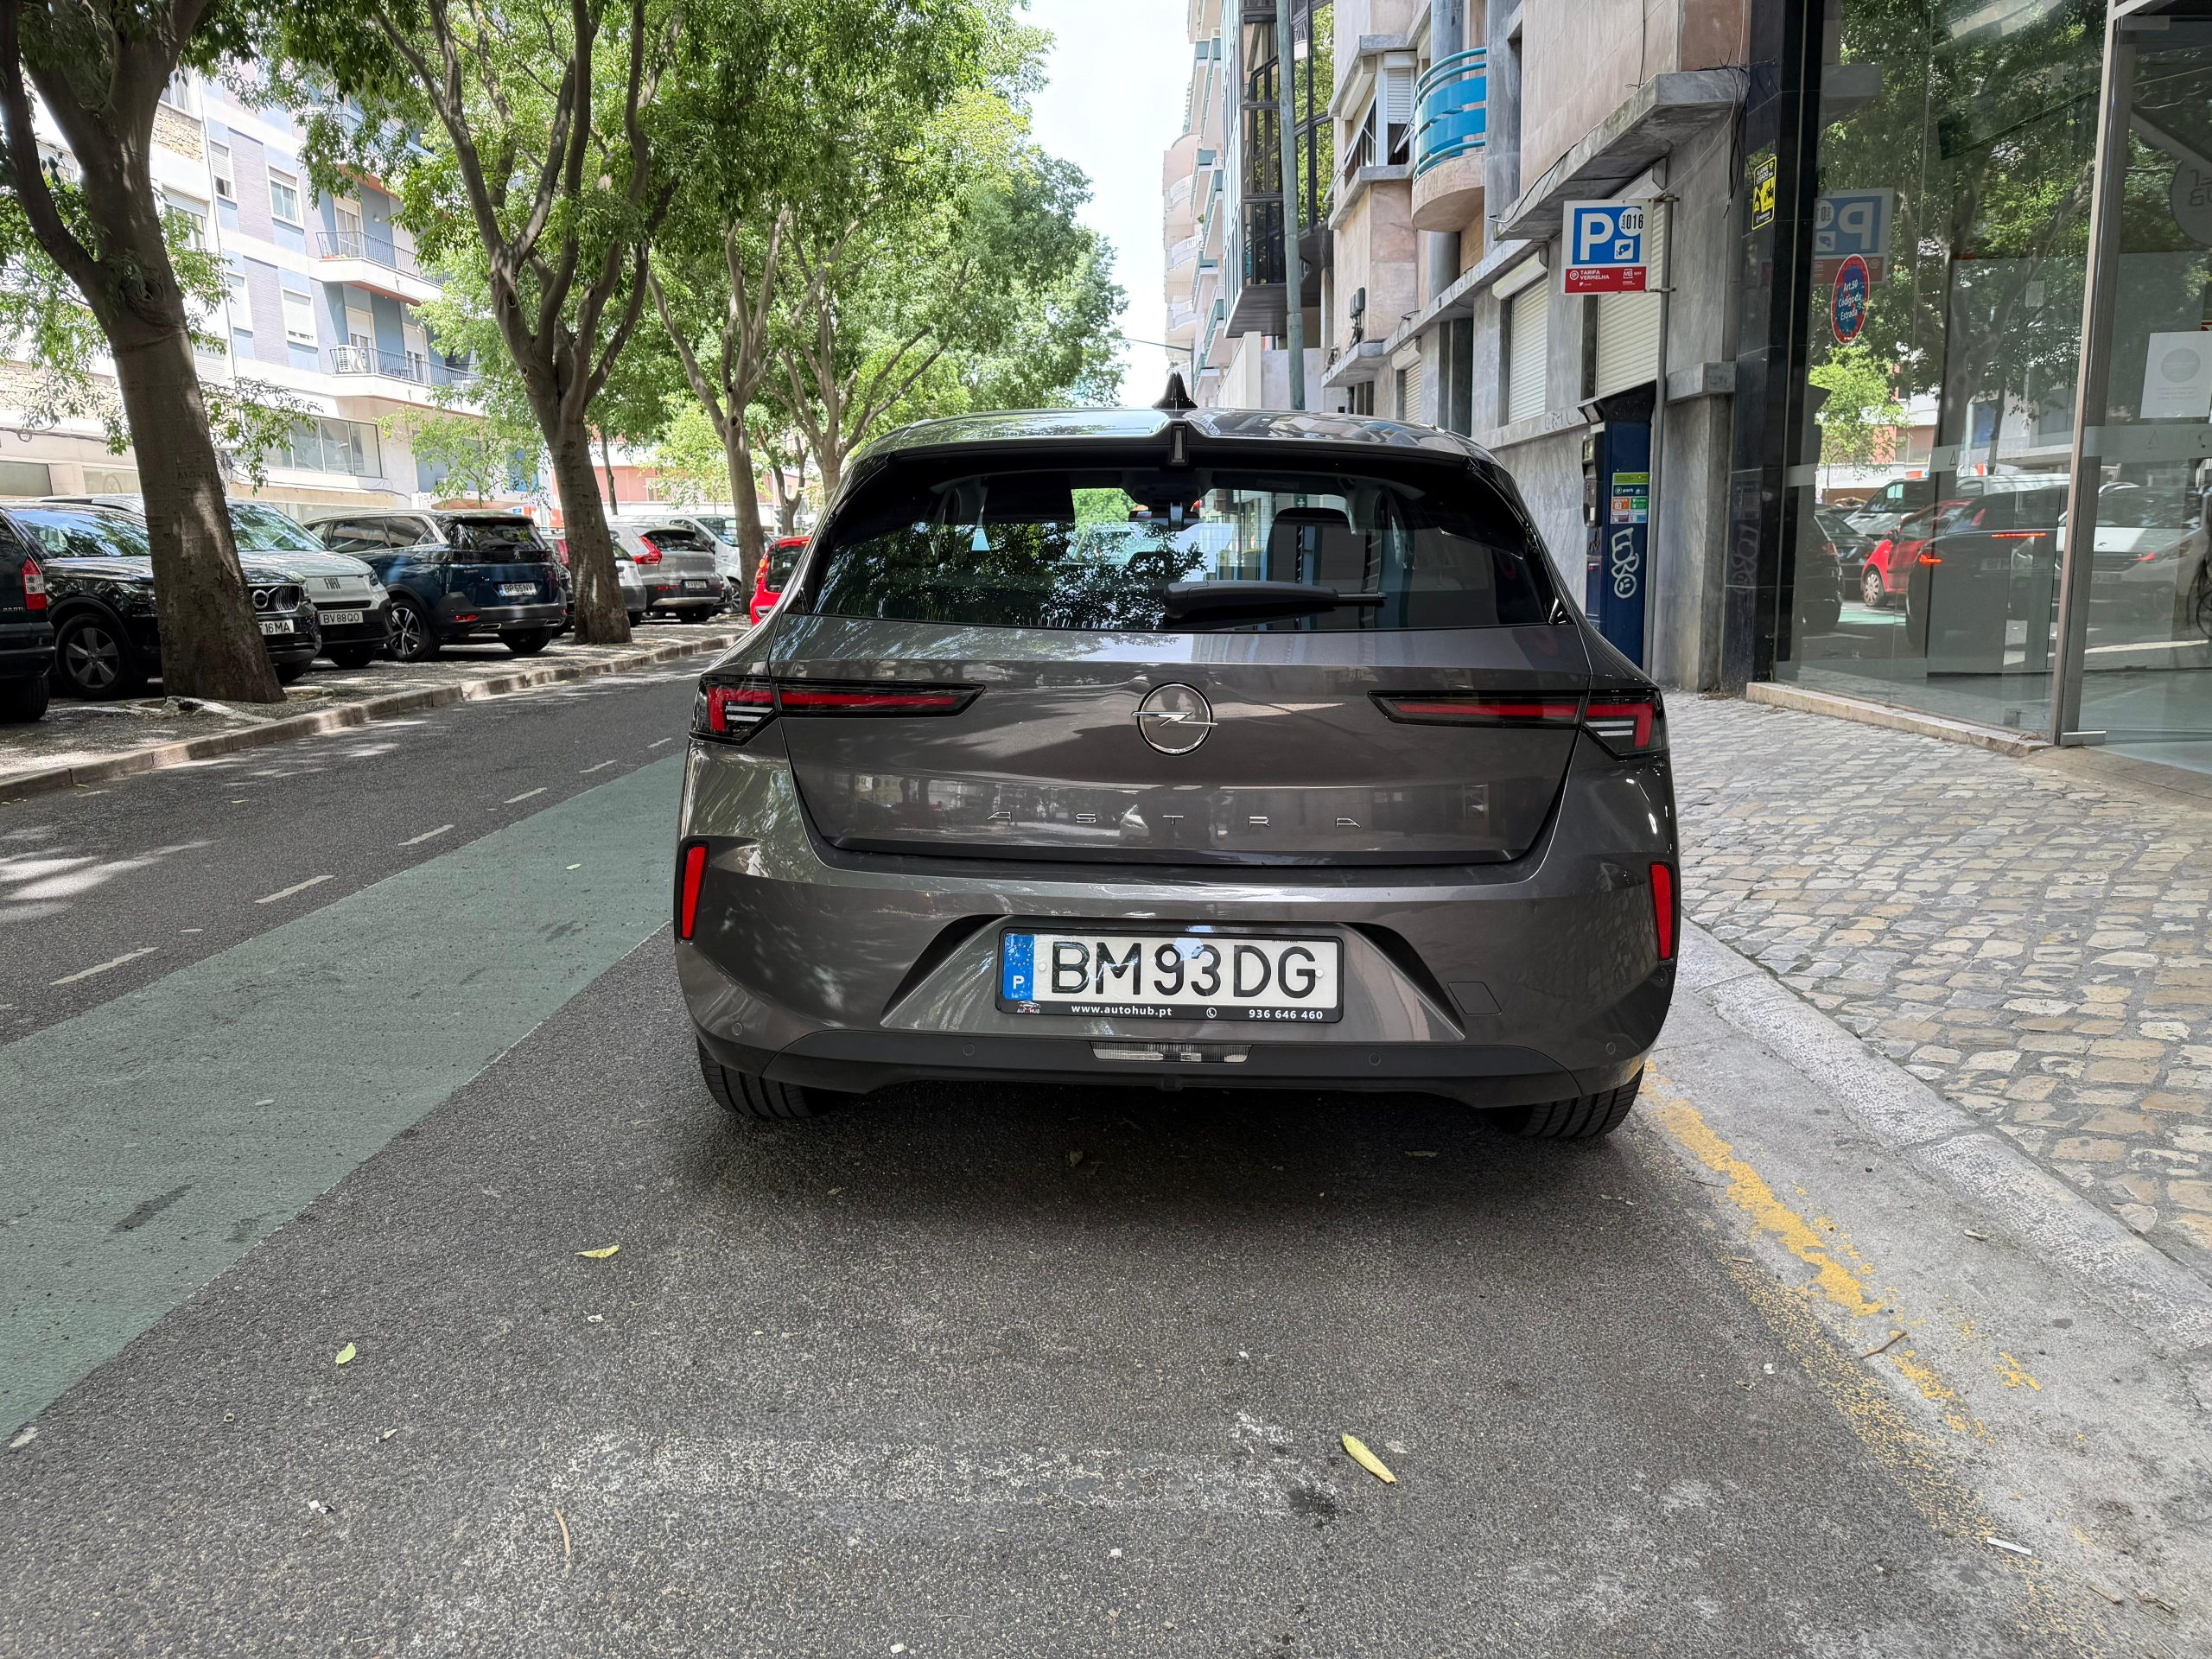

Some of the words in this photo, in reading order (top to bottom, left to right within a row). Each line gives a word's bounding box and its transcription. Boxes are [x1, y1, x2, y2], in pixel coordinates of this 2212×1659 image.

[1626, 214, 1643, 229] 016
[1580, 213, 1614, 260] P
[986, 810, 1361, 828] ASTRA
[1013, 976, 1025, 989] P
[1071, 1006, 1172, 1017] www.autohub.pt
[1249, 1009, 1270, 1019] 936
[1274, 1010, 1296, 1019] 646
[1300, 1011, 1323, 1020] 460
